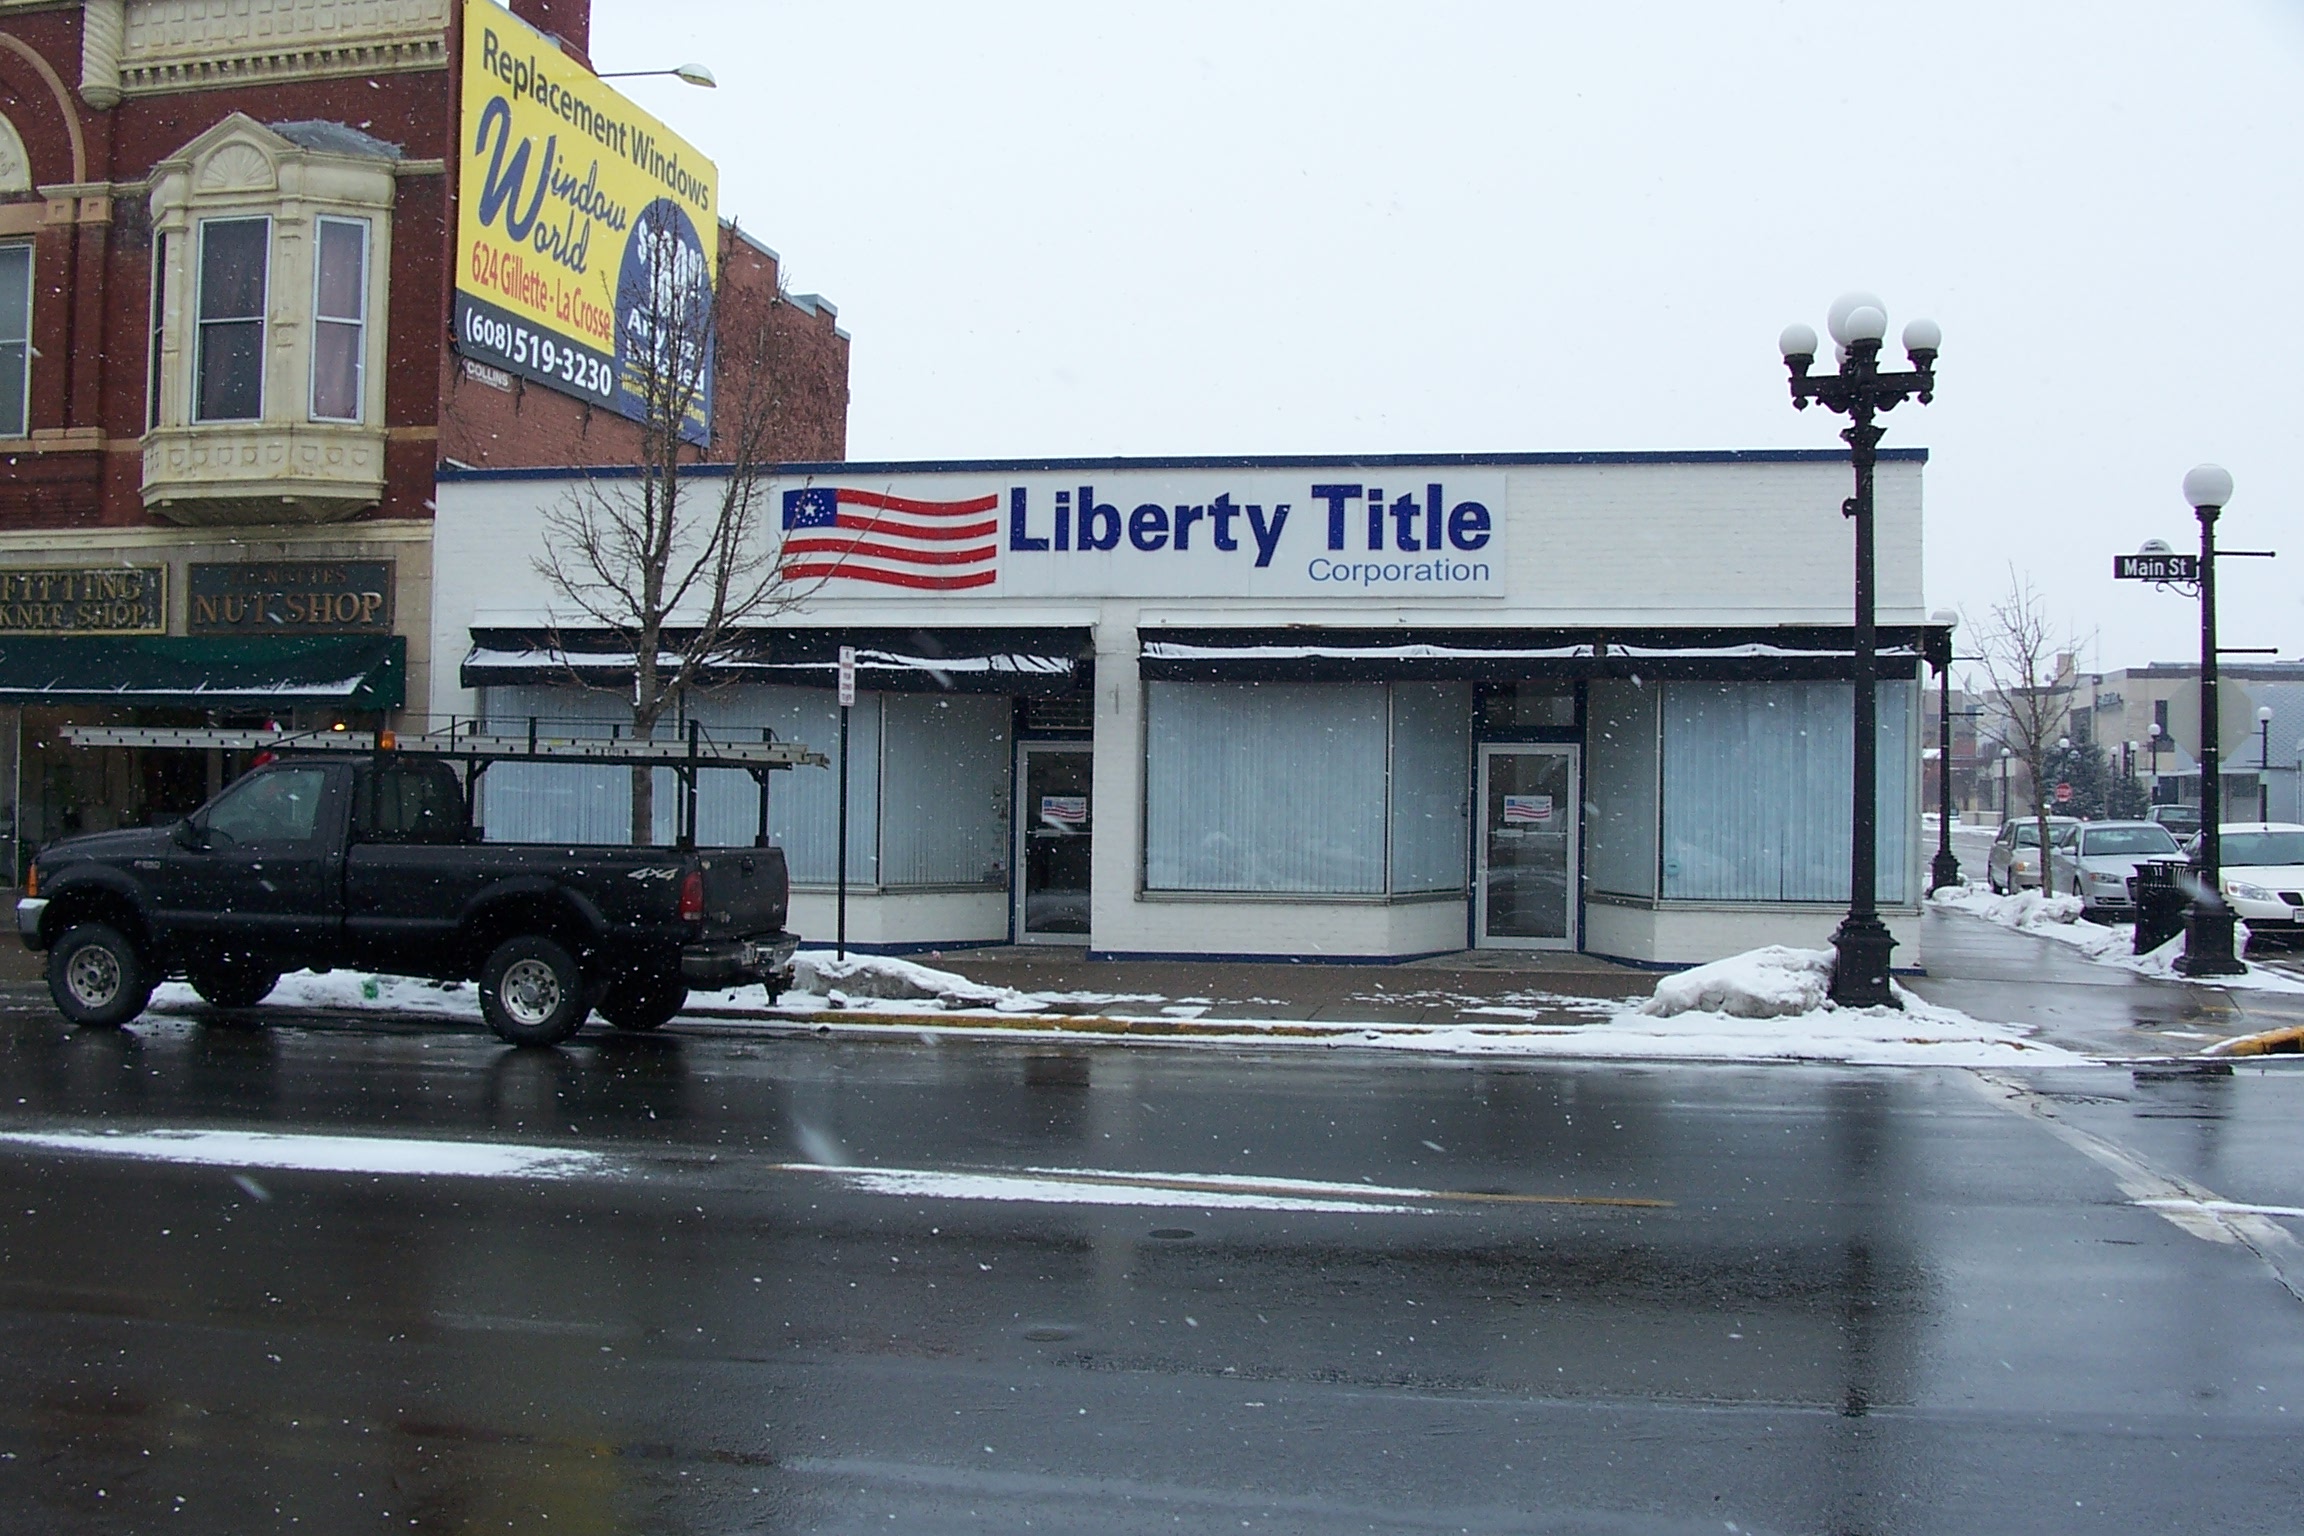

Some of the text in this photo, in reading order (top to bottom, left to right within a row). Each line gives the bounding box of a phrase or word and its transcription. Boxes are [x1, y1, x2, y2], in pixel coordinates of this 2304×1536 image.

[483, 27, 709, 211] Replacement Windows
[475, 96, 627, 242] Window
[472, 240, 498, 290] 624
[500, 252, 548, 313] Gillette
[556, 277, 570, 323] La
[573, 286, 611, 342] Crosse
[467, 361, 509, 387] COLLINS
[1010, 483, 1492, 568] Liberty Title
[1308, 558, 1490, 587] Corporation
[2124, 558, 2187, 576] Main St
[76, 603, 146, 626] SHOP
[194, 592, 383, 625] NUT SHOP
